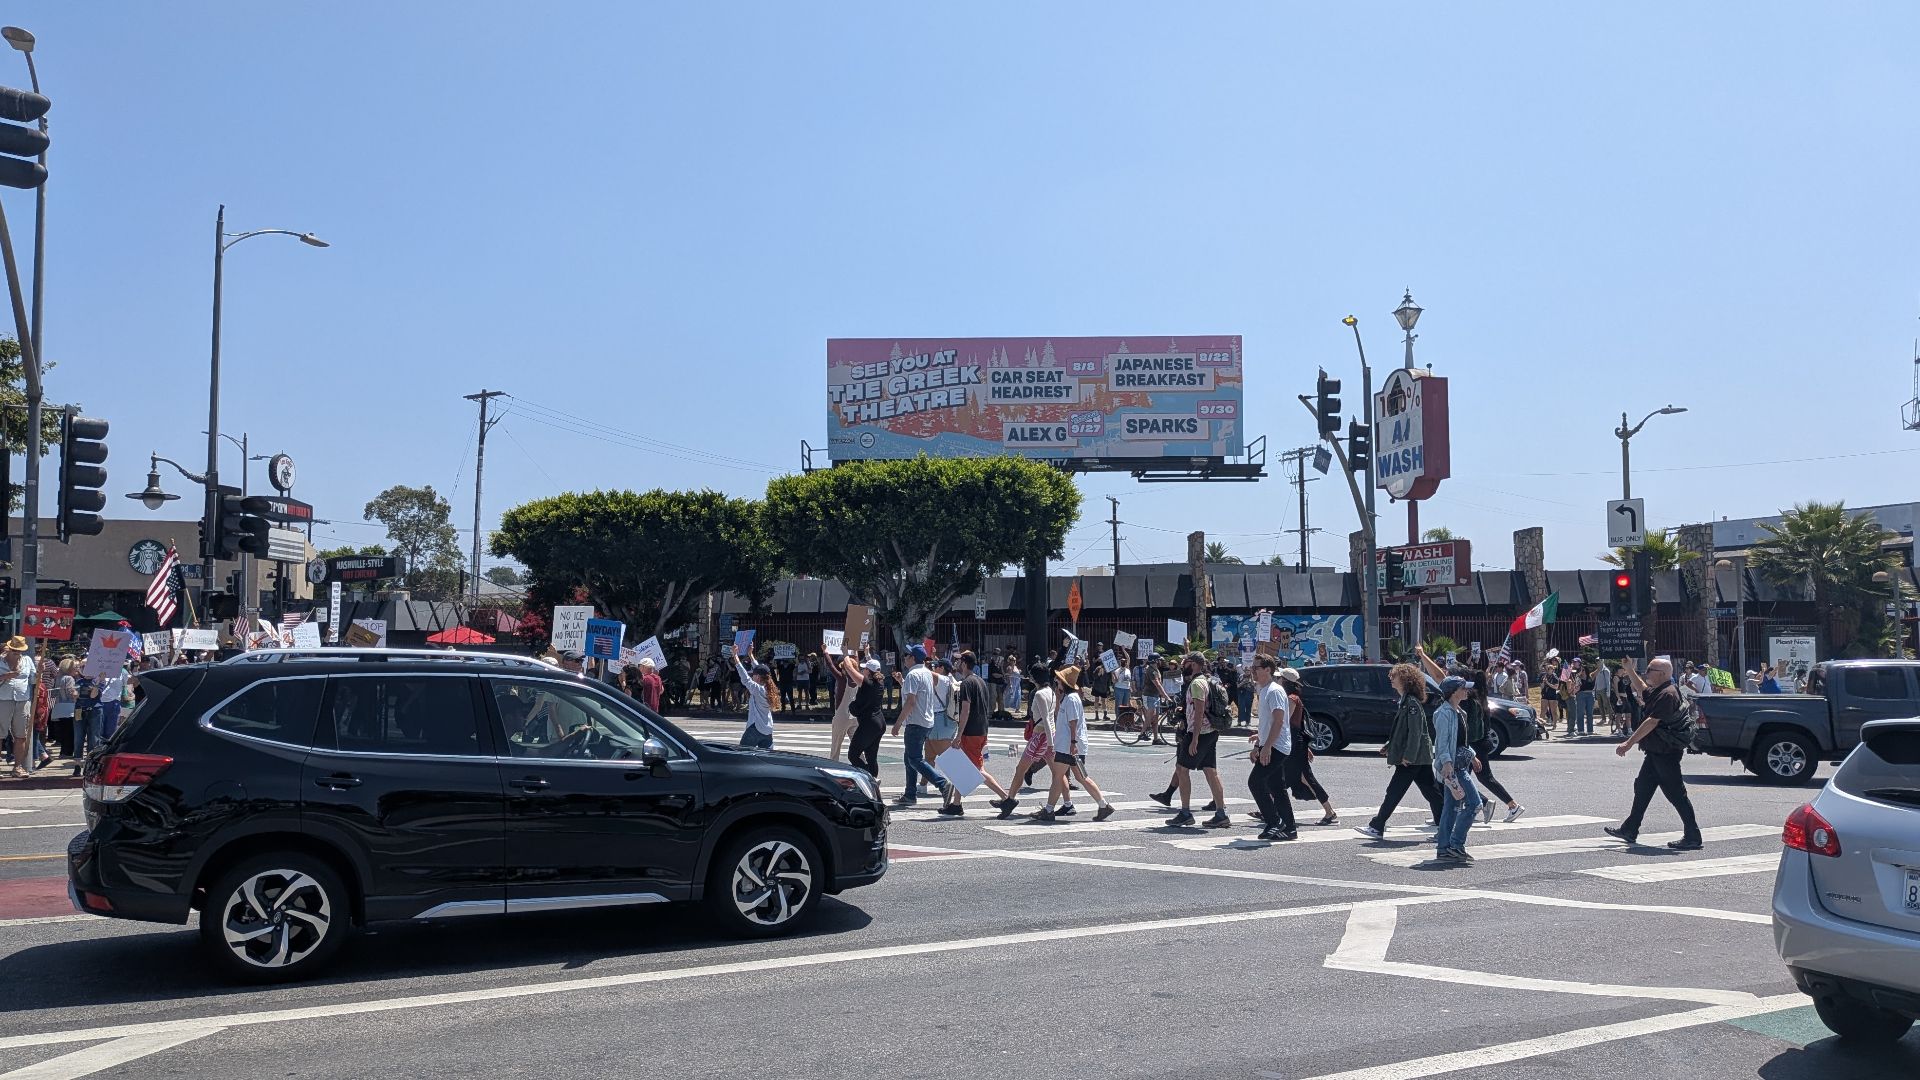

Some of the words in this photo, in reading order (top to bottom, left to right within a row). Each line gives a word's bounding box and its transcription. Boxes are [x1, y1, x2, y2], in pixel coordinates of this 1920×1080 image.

[851, 360, 890, 381] SEE
[891, 352, 930, 374] YOU
[932, 350, 957, 366] AT
[1072, 361, 1096, 372] 8/8
[1115, 357, 1194, 371] JAPANESE
[991, 370, 1025, 383] CAR
[1026, 370, 1064, 383] SEAT
[1115, 373, 1206, 387] BREAKFAST
[828, 380, 883, 403] THE
[887, 365, 981, 397] GREEK
[991, 385, 1073, 399] HEADREST
[843, 387, 967, 424] THEATRE
[1200, 405, 1235, 415] 9/30
[1071, 424, 1101, 433] 9/27
[1125, 418, 1198, 434] SPARKS
[1007, 427, 1054, 442] ALEX
[1055, 426, 1067, 441] G
[1378, 445, 1423, 478] WASH
[1418, 558, 1453, 567] DETAILING
[560, 611, 571, 621] NO
[573, 611, 584, 621] ICE
[572, 622, 581, 630] LA
[563, 639, 577, 649] USA
